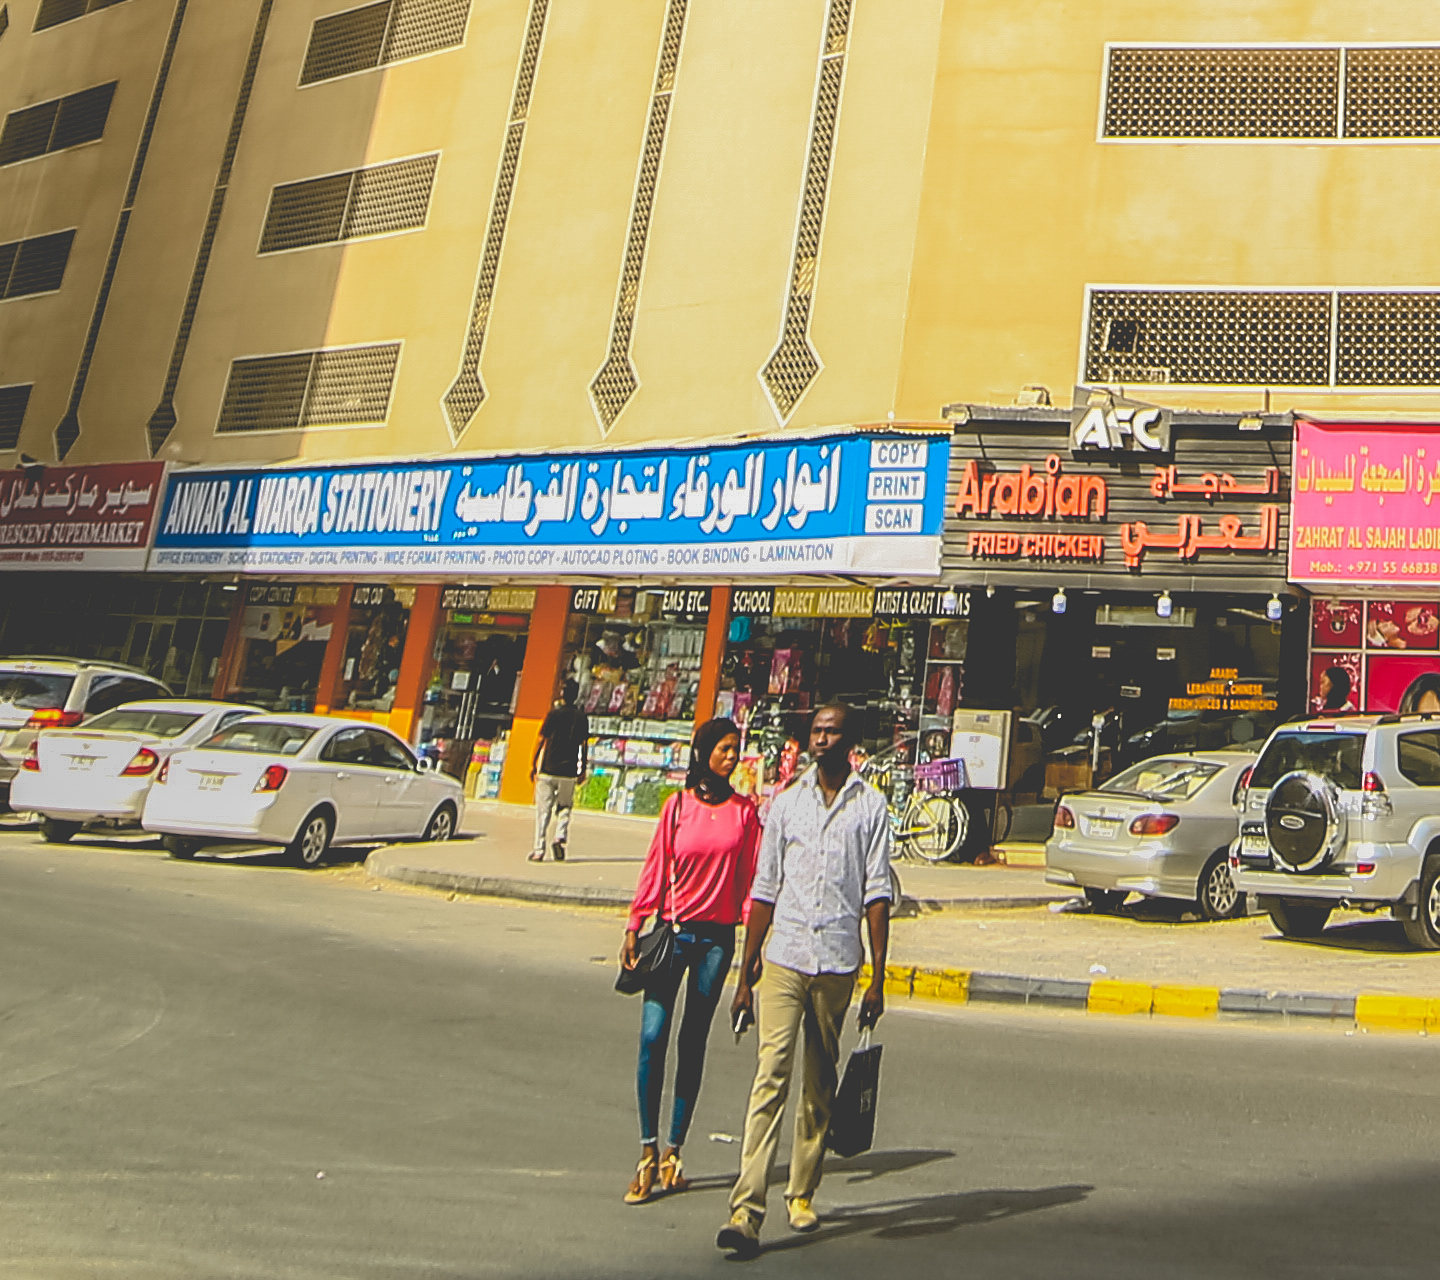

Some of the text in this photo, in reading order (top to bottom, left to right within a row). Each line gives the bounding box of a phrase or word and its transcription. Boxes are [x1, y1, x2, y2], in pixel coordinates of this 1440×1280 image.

[1075, 406, 1162, 450] AFC
[877, 443, 920, 464] COPY
[873, 475, 920, 496] PRINT
[955, 454, 1108, 517] Arabian
[1151, 464, 1280, 499] الدجاج
[1298, 448, 1356, 506] للسيدات
[454, 444, 841, 537] انوار الورقاء لتجارة القرطاسية
[164, 469, 451, 537] ANWAR AL WARQA STATIONERY
[874, 508, 912, 529] SCAN
[50, 521, 145, 544] SUPERMARKET
[1121, 505, 1280, 567] العربي
[1296, 526, 1344, 549] ZAHRAT
[1347, 526, 1362, 549] AL
[1366, 527, 1406, 550] SAJAH
[257, 551, 305, 566] STATIONERY
[308, 550, 339, 565] DIGITAL
[339, 550, 378, 565] PRINTING
[383, 549, 406, 565] WIDE
[405, 549, 443, 565] FORMAT
[442, 549, 486, 565] PRINTING
[492, 549, 526, 565] PHOTO
[526, 549, 555, 565] COPY
[560, 548, 610, 565] AUTOCAD
[611, 548, 659, 566] PLOTING
[666, 547, 700, 565] BOOK
[701, 546, 750, 564] BINDING
[759, 543, 834, 562] LAMINATION
[968, 532, 1104, 558] FRIED CHICKEN
[1347, 562, 1377, 574] +971
[1382, 562, 1397, 574] 55
[574, 589, 599, 611] GIFT
[732, 590, 872, 613] SCHOOL PROJECT MATERIALS
[874, 591, 935, 613] ARTIST & CRAFT
[1210, 668, 1238, 680] ARABIC
[1230, 683, 1263, 696] CHINESE
